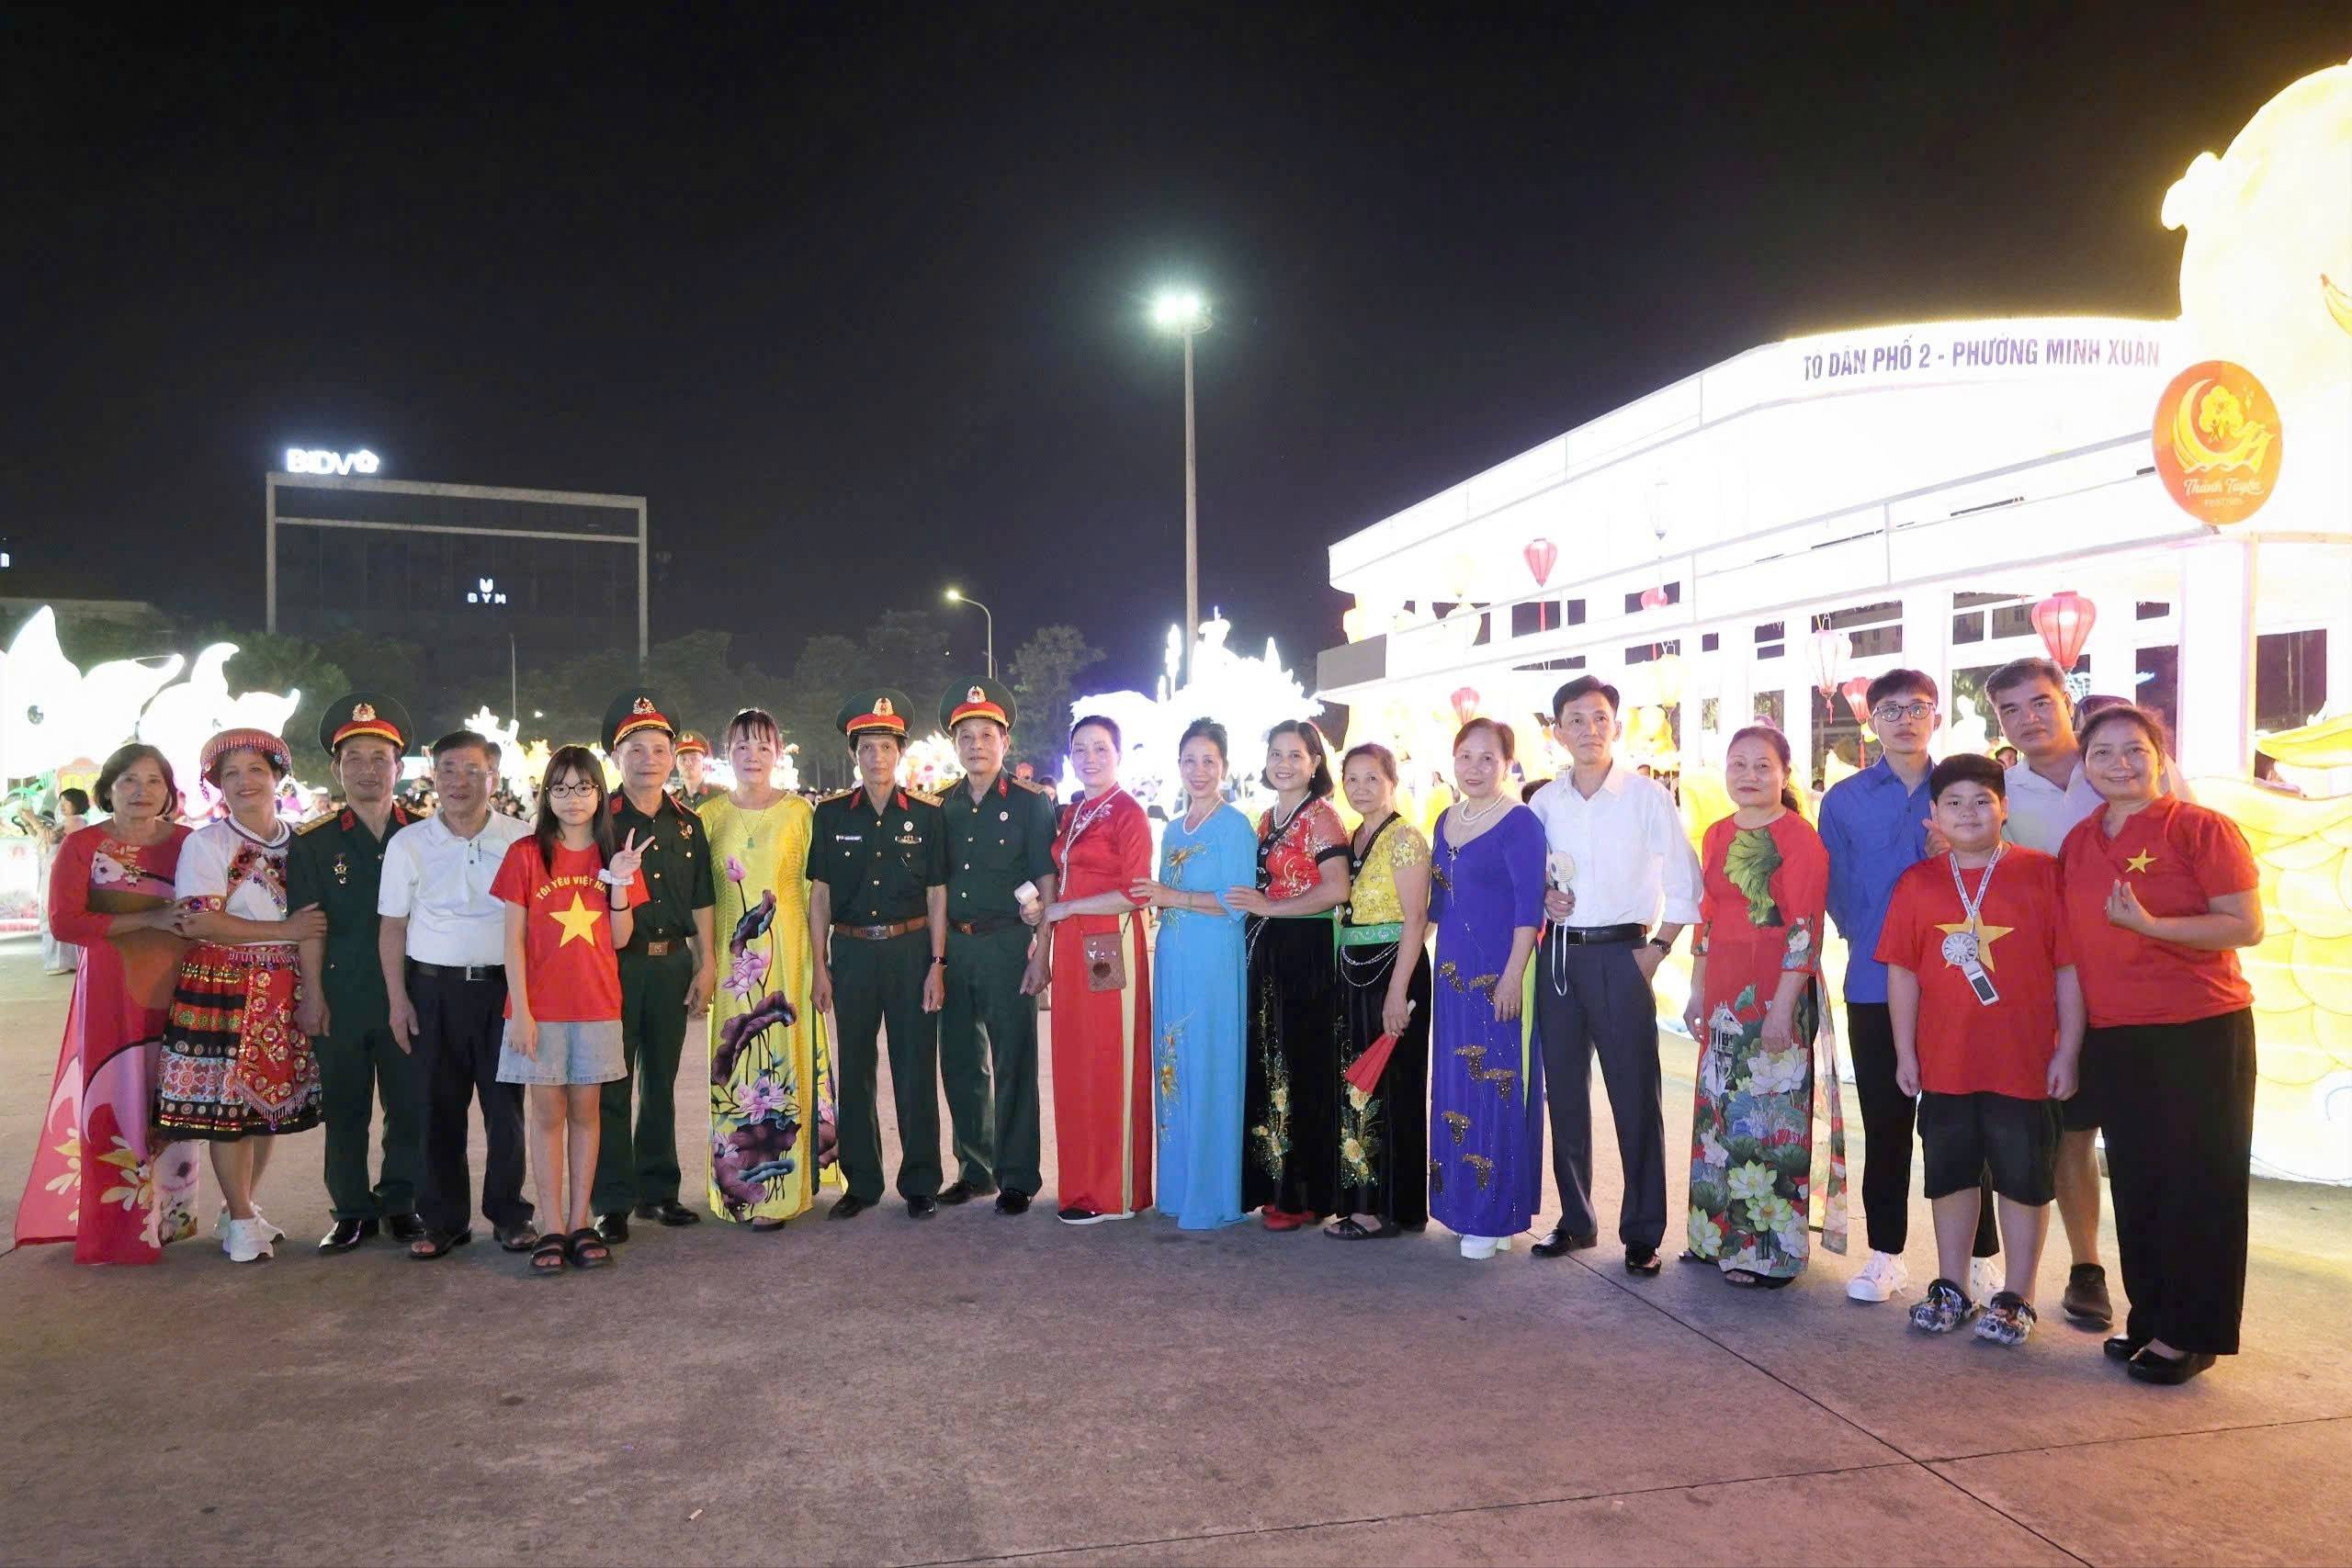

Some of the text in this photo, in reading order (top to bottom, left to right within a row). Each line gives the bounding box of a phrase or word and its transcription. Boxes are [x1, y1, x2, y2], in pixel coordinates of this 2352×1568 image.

[1872, 334, 1913, 372] PHỐ
[1919, 344, 1931, 368] 2
[2046, 339, 2100, 365] MINH
[468, 592, 506, 604] GYM
[551, 876, 570, 888] YÊU
[572, 874, 594, 887] VIỆT
